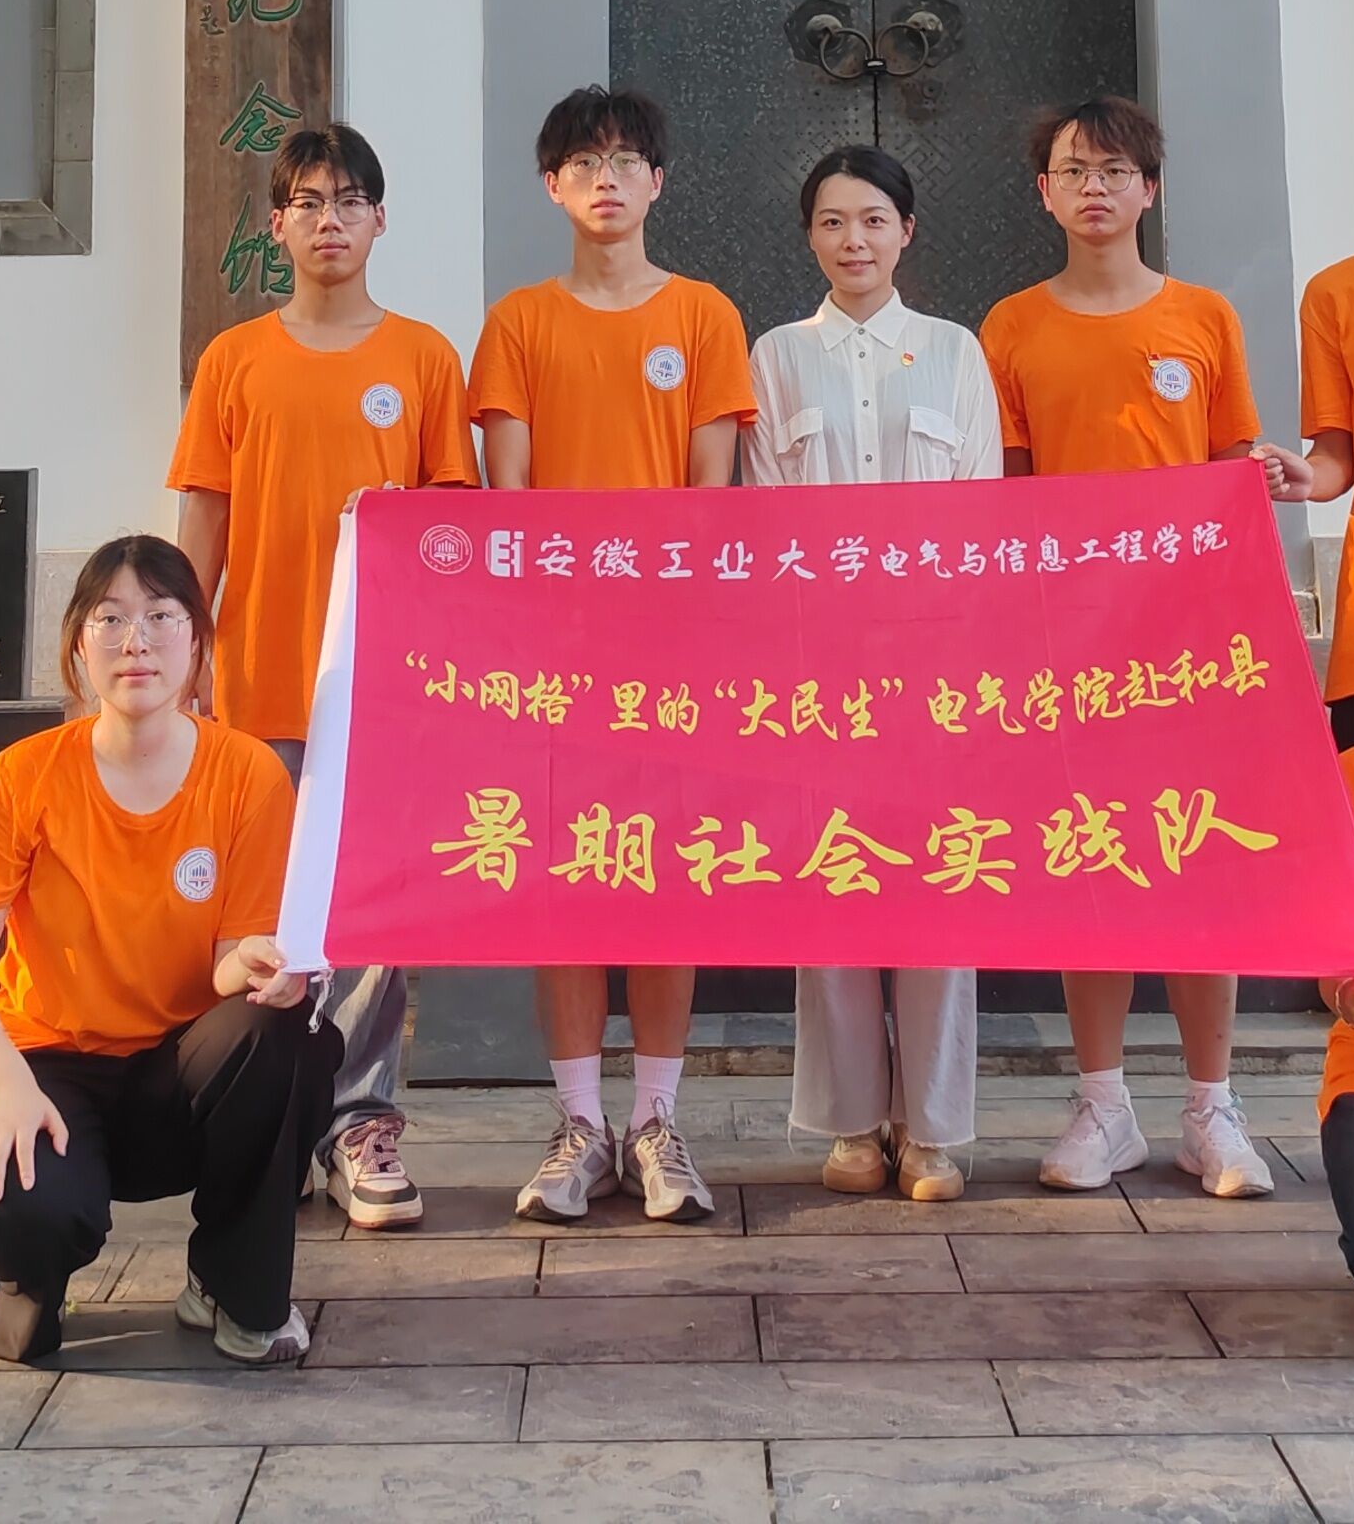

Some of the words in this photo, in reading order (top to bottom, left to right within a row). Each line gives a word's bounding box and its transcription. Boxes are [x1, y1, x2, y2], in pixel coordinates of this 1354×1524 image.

[430, 786, 1279, 896] 暑期社会实践队
